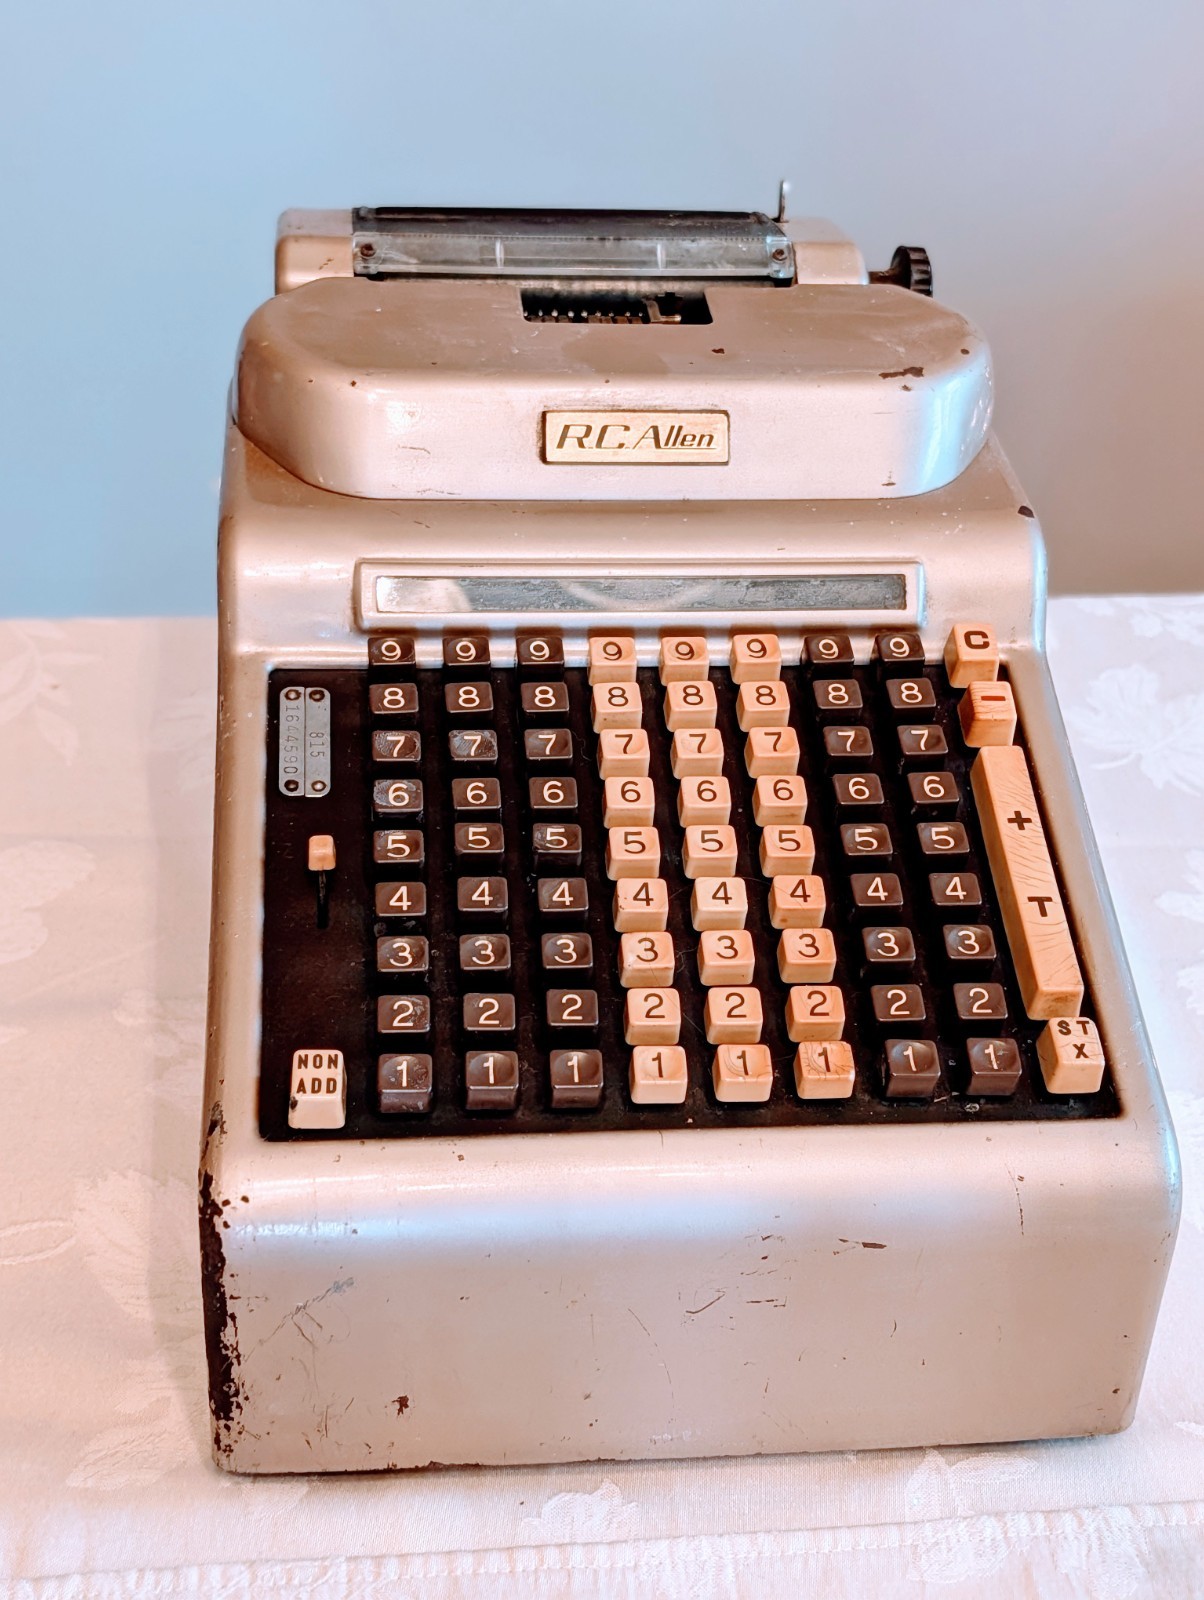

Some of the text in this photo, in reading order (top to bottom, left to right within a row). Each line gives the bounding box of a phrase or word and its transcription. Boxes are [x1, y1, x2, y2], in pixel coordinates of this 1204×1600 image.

[381, 641, 401, 661] 9
[456, 641, 476, 661] 9
[530, 641, 549, 660] 9
[675, 642, 695, 660] 9
[747, 639, 767, 658] 9
[819, 639, 838, 658] 9
[890, 638, 909, 657] 9
[964, 631, 990, 649] C
[603, 642, 622, 661] 9
[383, 688, 405, 708] 8
[459, 686, 480, 707] 8
[535, 686, 555, 707] 8
[608, 687, 628, 707] 8
[683, 685, 703, 705] 8
[756, 685, 776, 705] 8
[828, 684, 848, 704] 8
[901, 683, 922, 703] 8
[309, 731, 325, 758] 815
[386, 735, 405, 757] 7
[464, 735, 482, 757] 7
[539, 734, 556, 755] 7
[615, 734, 633, 754] 7
[689, 733, 706, 753] 7
[764, 732, 781, 752] 7
[838, 731, 855, 751] 7
[911, 729, 928, 750] 7
[389, 783, 409, 806] 6
[467, 782, 487, 804] 6
[543, 781, 564, 803] 6
[621, 781, 641, 802] 6
[697, 780, 717, 802] 6
[773, 779, 793, 800] 6
[849, 778, 869, 799] 6
[924, 776, 944, 797] 6
[387, 832, 410, 857] 5
[468, 827, 490, 848] 5
[546, 828, 567, 848] 5
[624, 831, 646, 854] 5
[701, 830, 723, 852] 5
[779, 830, 801, 851] 5
[855, 826, 878, 850] 5
[932, 826, 954, 849] 5
[390, 886, 411, 910] 4
[472, 881, 493, 905] 4
[553, 882, 573, 905] 4
[633, 882, 654, 906] 4
[712, 882, 732, 904] 4
[790, 879, 811, 902] 4
[867, 877, 888, 900] 4
[946, 877, 966, 899] 4
[1027, 896, 1053, 917] T
[472, 940, 495, 964] 3
[555, 939, 577, 963] 3
[636, 937, 658, 962] 3
[716, 935, 738, 959] 3
[798, 934, 820, 958] 3
[878, 933, 899, 956] 3
[958, 930, 980, 954] 3
[390, 942, 412, 966] 3
[479, 998, 499, 1024] 2
[562, 994, 582, 1020] 2
[644, 993, 665, 1018] 2
[725, 993, 747, 1018] 2
[808, 990, 829, 1016] 2
[888, 990, 909, 1014] 2
[970, 988, 992, 1013] 2
[393, 1001, 413, 1026] 2
[1057, 1020, 1090, 1036] ST
[297, 1053, 339, 1070] NON
[818, 1047, 831, 1072] 1
[904, 1046, 916, 1071] 1
[985, 1044, 998, 1069] 1
[1073, 1043, 1089, 1059] X
[397, 1061, 407, 1087] 1
[484, 1057, 495, 1084] 1
[568, 1055, 578, 1082] 1
[652, 1052, 663, 1078] 1
[737, 1050, 749, 1076] 1
[296, 1077, 337, 1095] ADD
